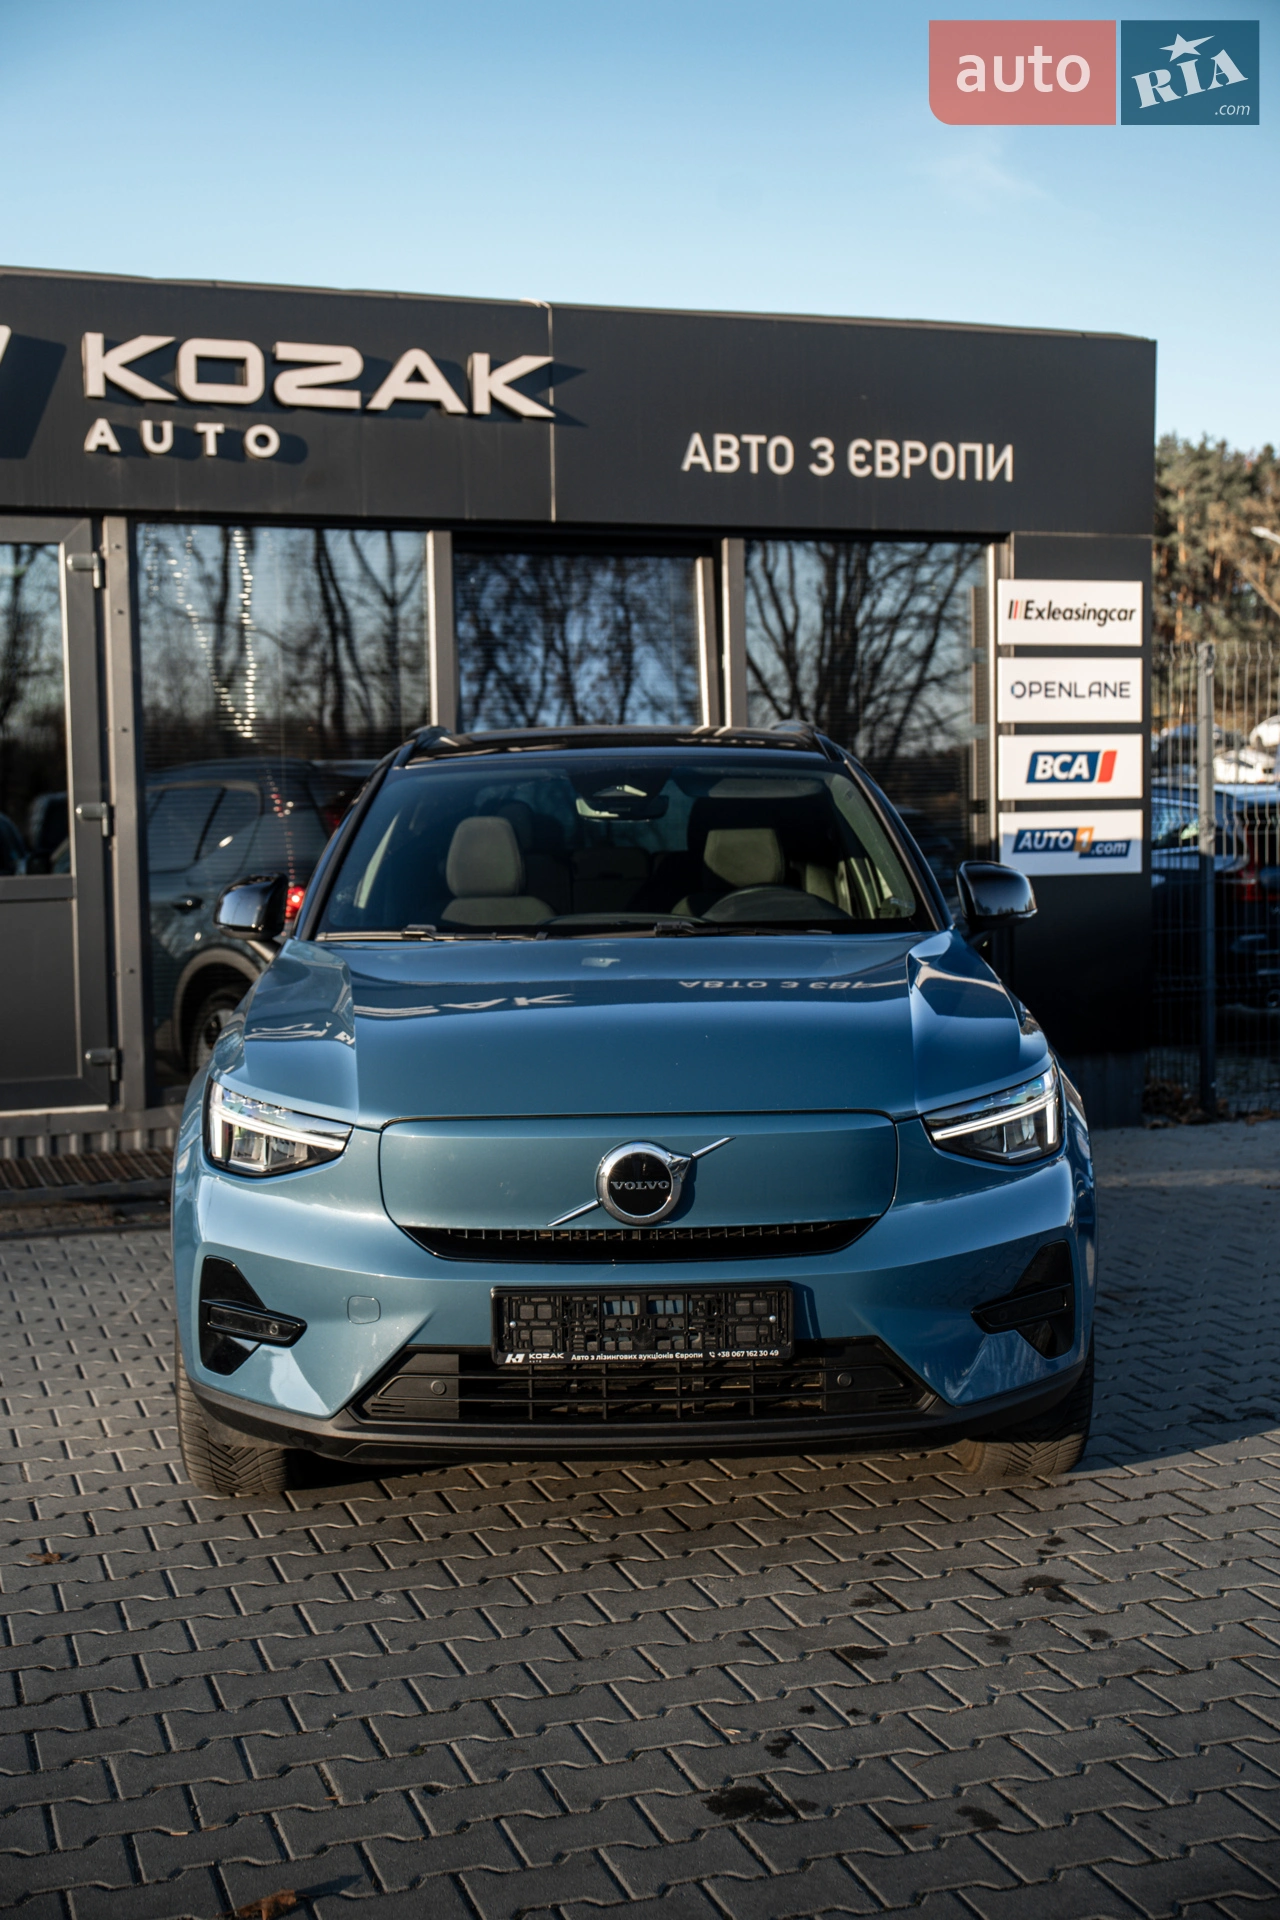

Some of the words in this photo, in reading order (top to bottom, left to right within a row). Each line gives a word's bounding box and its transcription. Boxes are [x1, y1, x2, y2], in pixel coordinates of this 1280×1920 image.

[81, 332, 556, 419] KOZAK
[84, 418, 281, 459] AUTO
[681, 432, 795, 476] АВТО
[808, 436, 836, 477] З
[847, 438, 1014, 482] ЄВРОПИ
[1024, 600, 1137, 626] Exleasingcar
[1011, 681, 1131, 699] OPENLANE
[1034, 754, 1091, 780] BCA
[610, 1180, 670, 1191] VOLVO
[638, 1351, 674, 1360] аукціонів
[675, 1351, 703, 1359] Європи
[717, 1350, 730, 1358] +38
[731, 1350, 745, 1358] 067
[746, 1349, 758, 1357] 162
